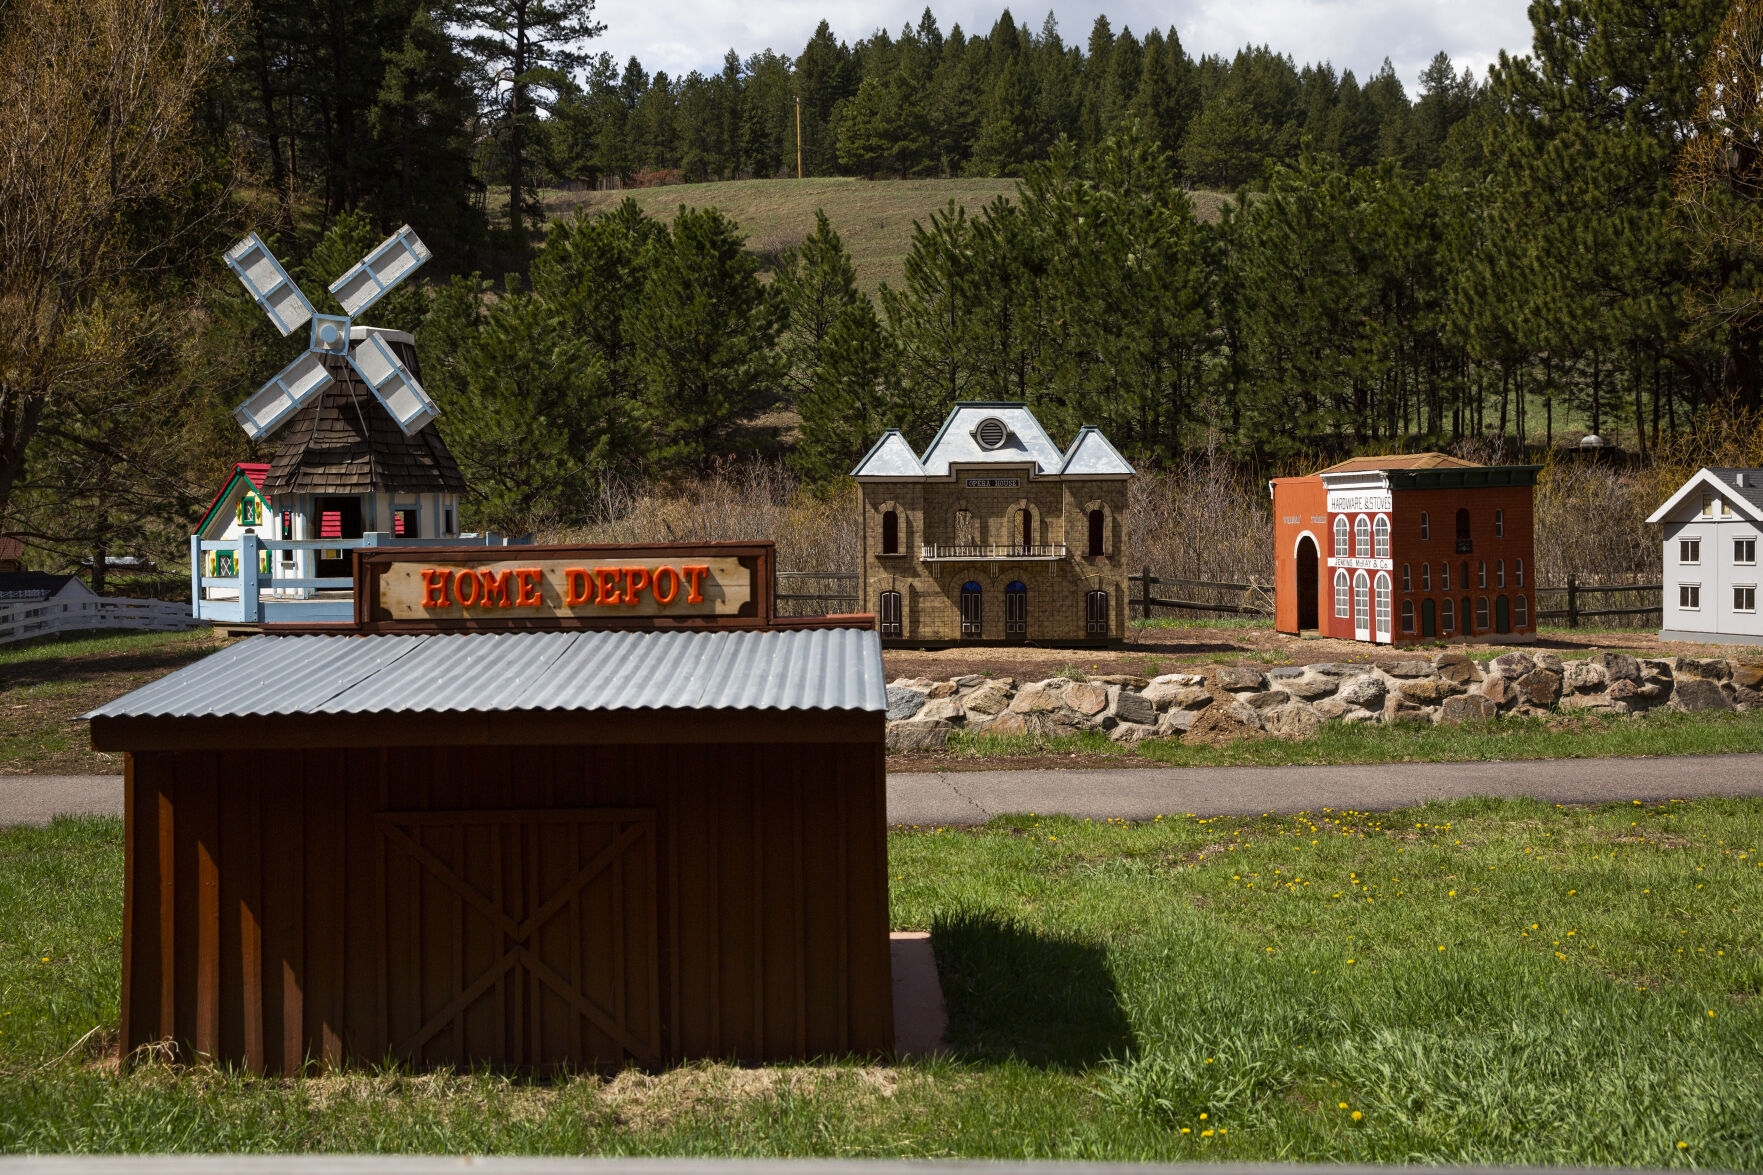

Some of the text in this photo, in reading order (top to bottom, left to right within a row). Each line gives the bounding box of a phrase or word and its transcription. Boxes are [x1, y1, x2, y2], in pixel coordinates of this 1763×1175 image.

[1331, 497, 1362, 510] HARDWARE
[420, 564, 708, 608] HOME DEPOT
